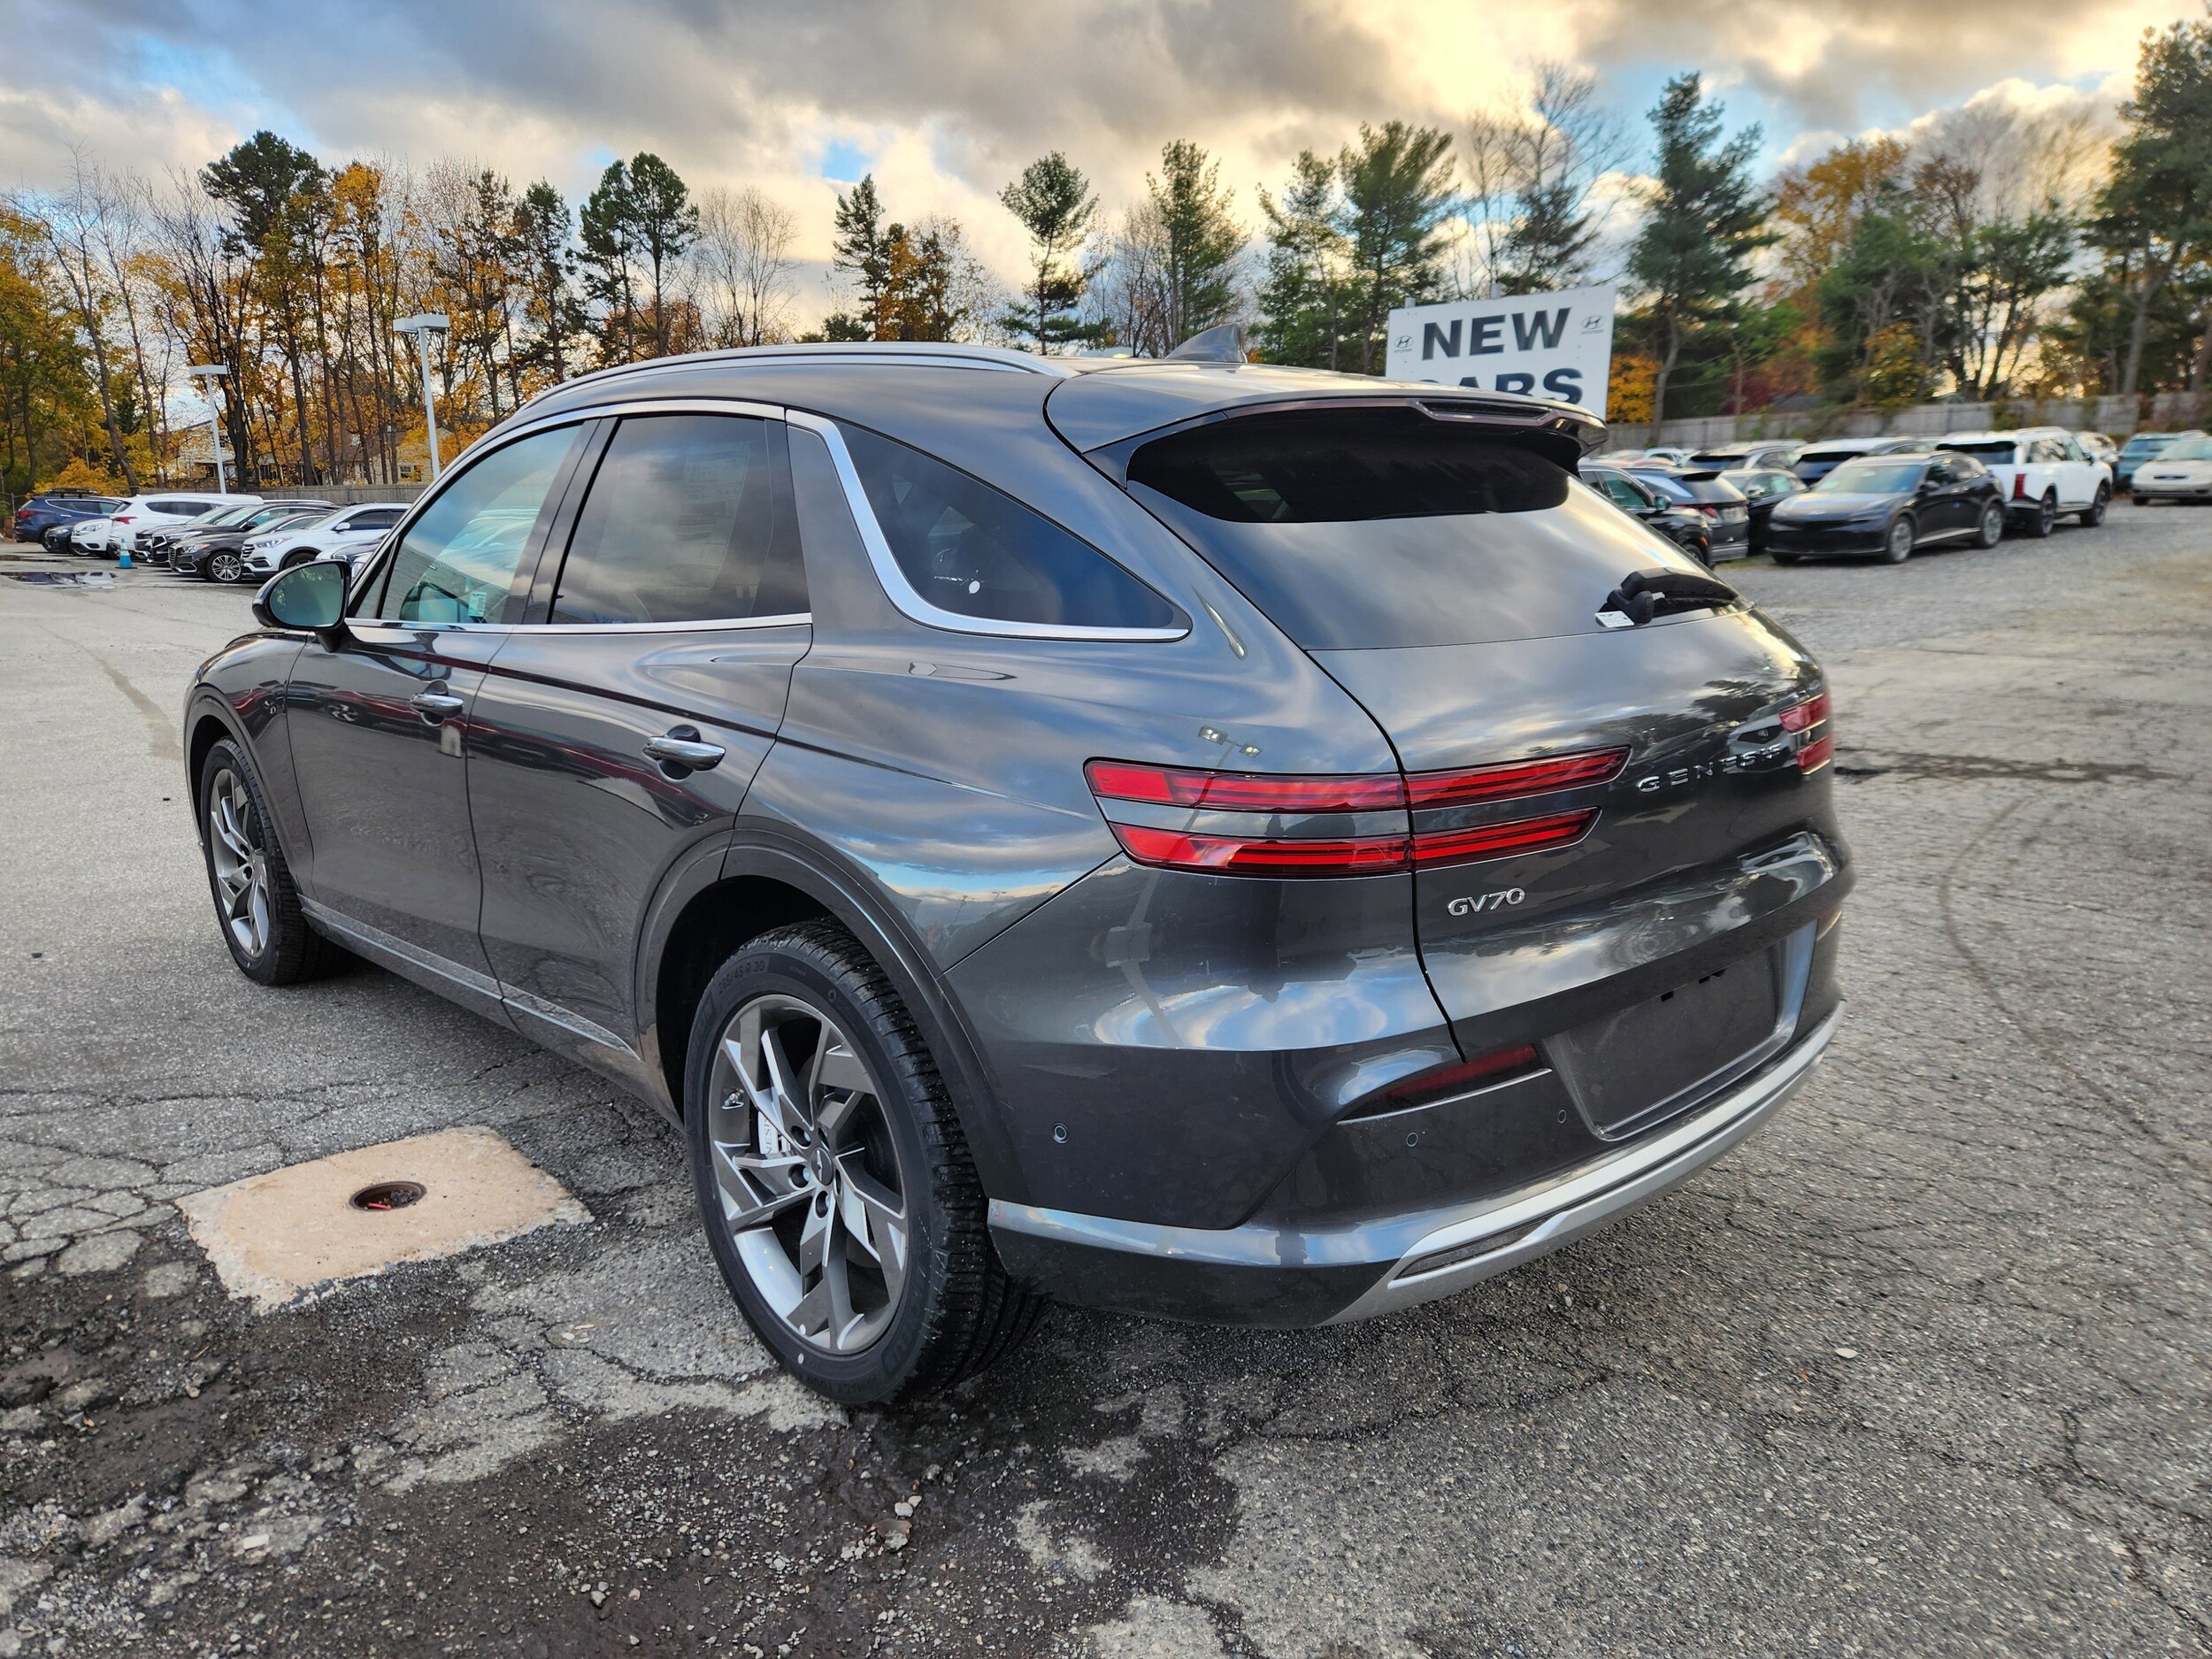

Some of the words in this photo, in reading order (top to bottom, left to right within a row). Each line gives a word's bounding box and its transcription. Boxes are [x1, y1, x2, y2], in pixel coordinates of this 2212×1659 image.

[1422, 307, 1572, 361] NEW
[1418, 367, 1584, 405] RS
[1637, 742, 1782, 793] GENESIS
[1447, 887, 1526, 917] GV70
[754, 960, 765, 972] 20
